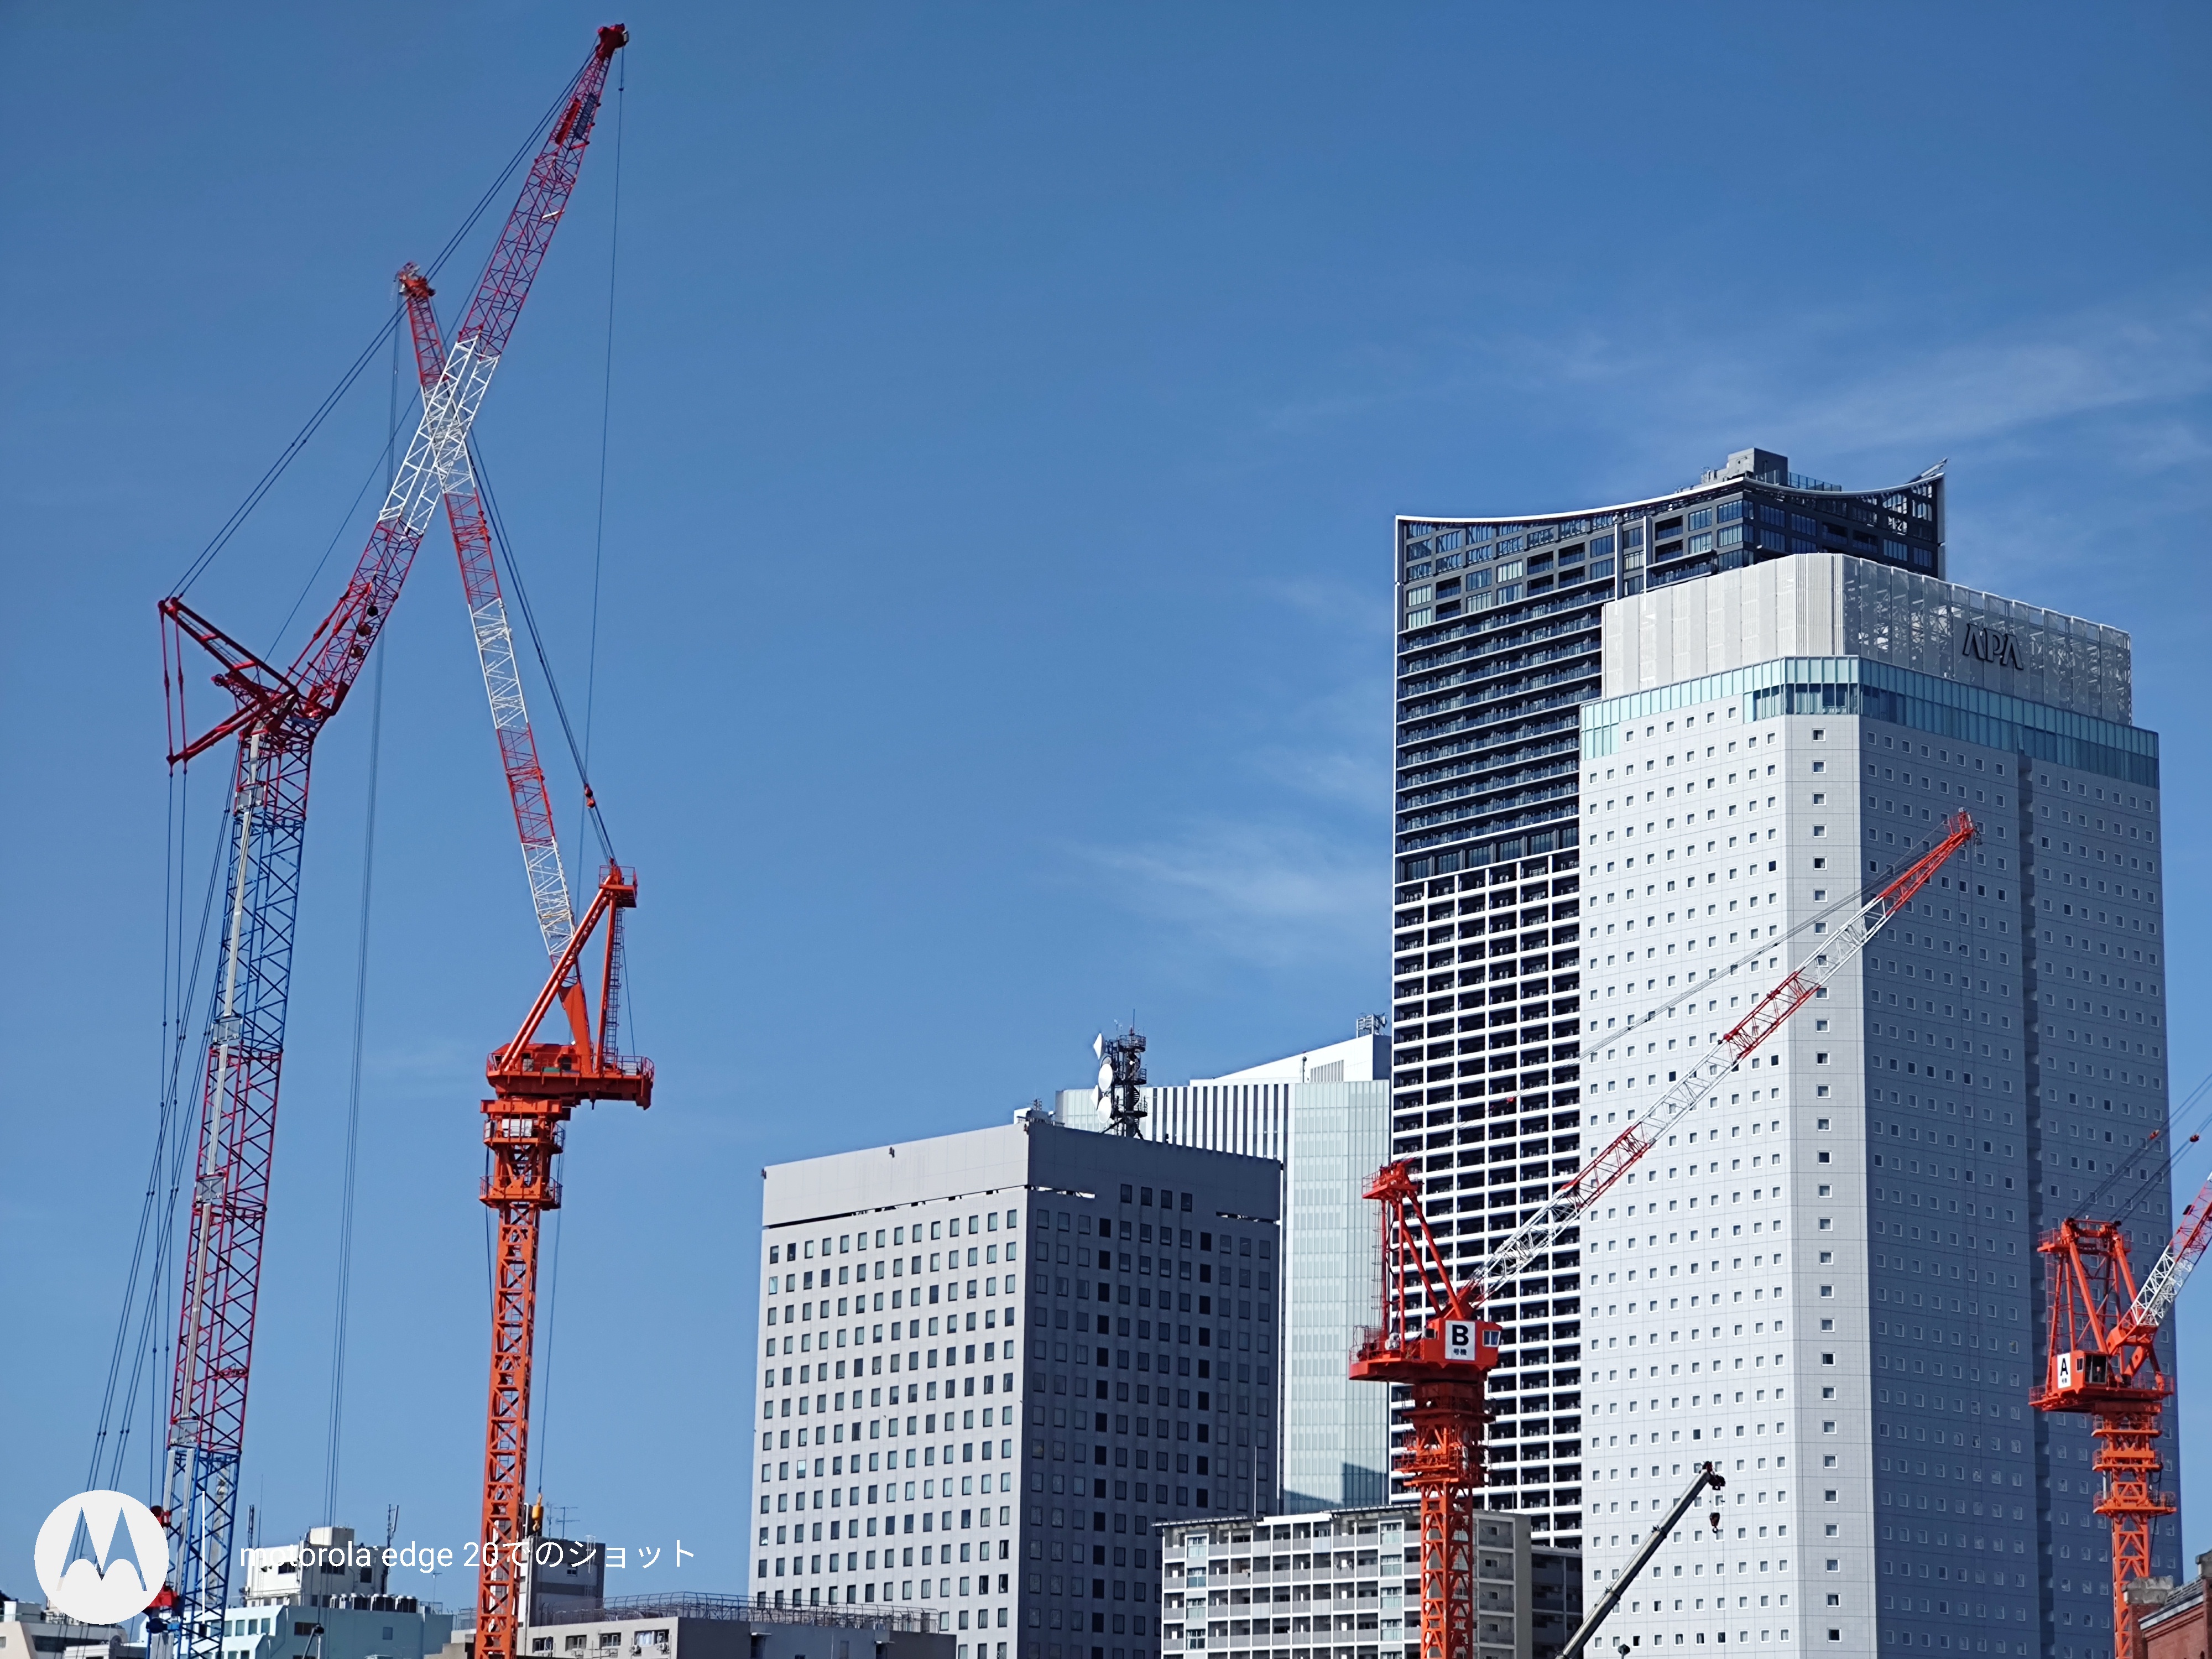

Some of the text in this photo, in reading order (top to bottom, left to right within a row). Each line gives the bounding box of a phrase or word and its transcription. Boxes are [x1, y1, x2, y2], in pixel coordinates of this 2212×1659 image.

[1963, 623, 2024, 670] APA
[1452, 1324, 1469, 1346] B
[2060, 1358, 2068, 1376] A
